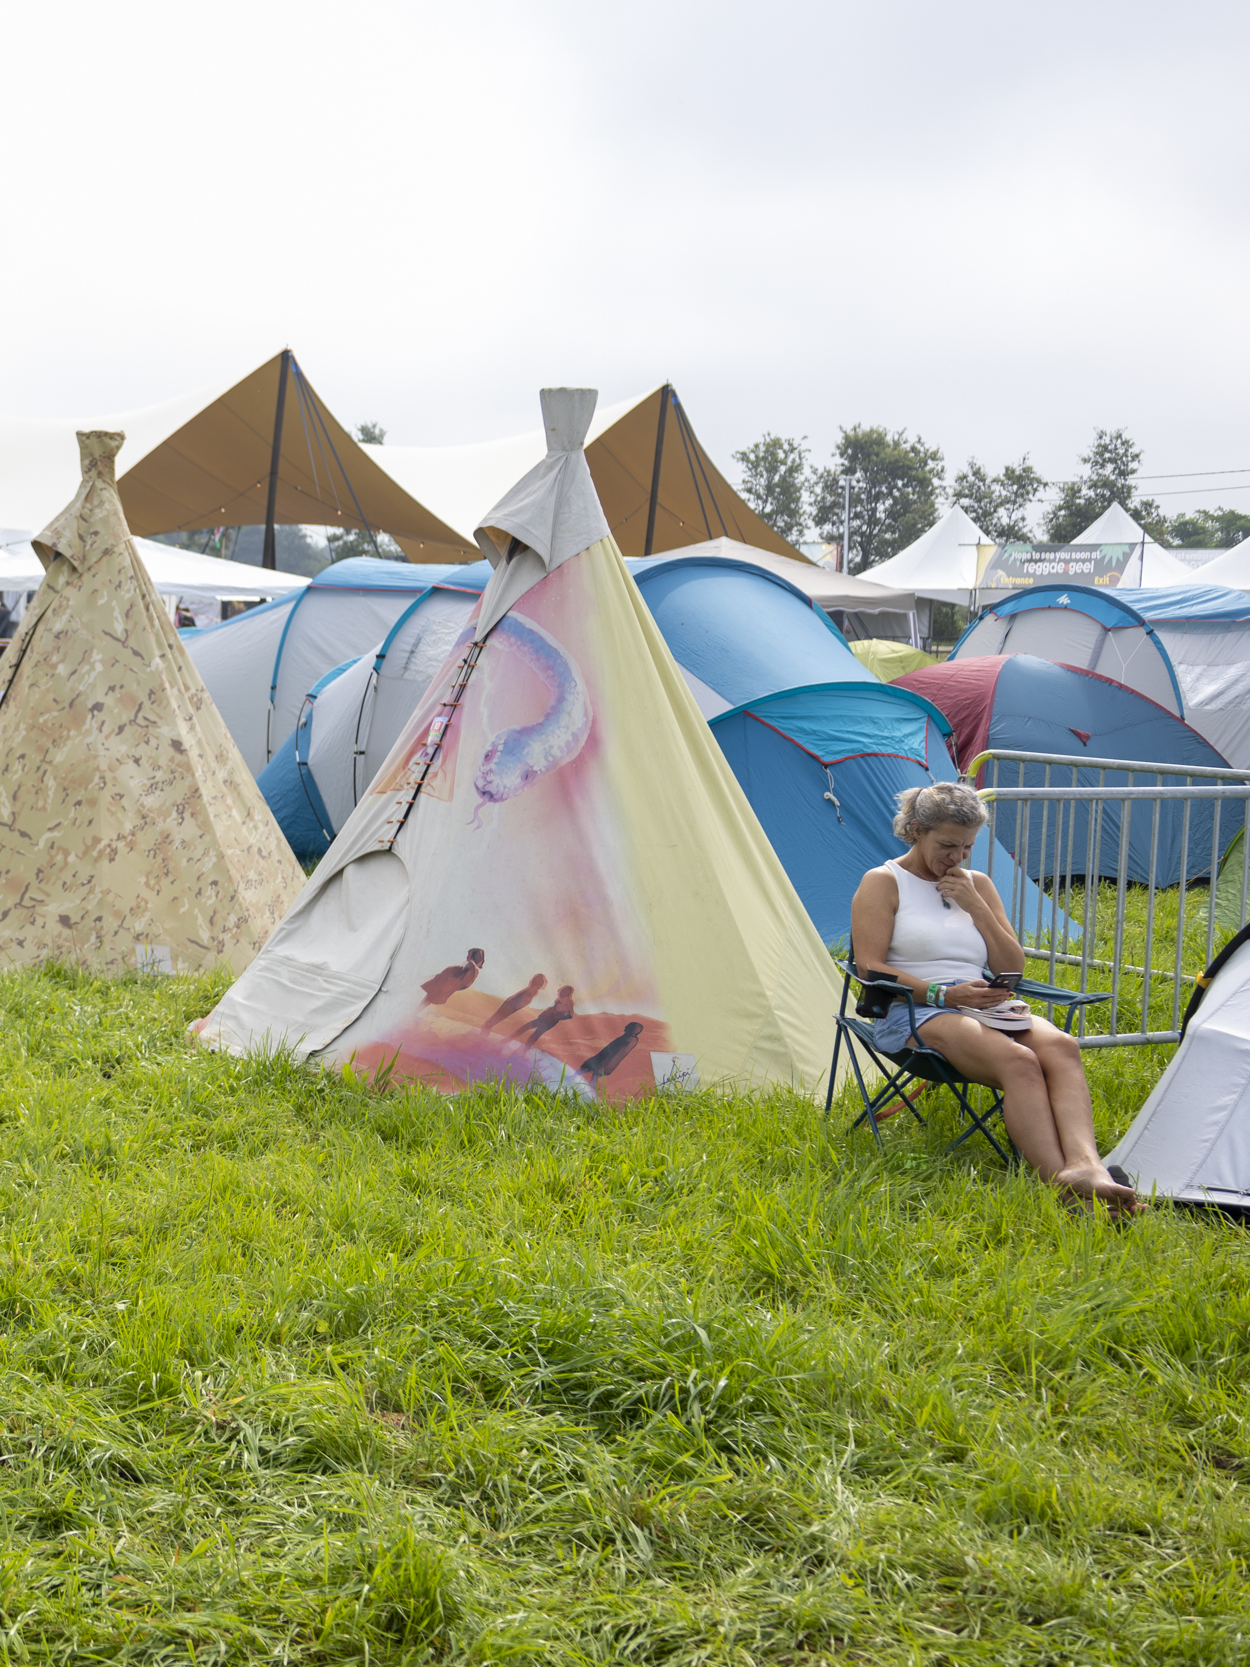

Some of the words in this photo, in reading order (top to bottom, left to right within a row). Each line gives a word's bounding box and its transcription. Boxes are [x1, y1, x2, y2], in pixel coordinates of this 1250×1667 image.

[1012, 551, 1032, 562] Hope
[1032, 551, 1040, 560] to
[1041, 552, 1055, 560] see
[1055, 552, 1071, 562] you
[1071, 551, 1091, 559] soon
[1091, 550, 1100, 559] at
[1024, 561, 1064, 575] reggae
[1068, 560, 1094, 575] geel
[1001, 576, 1034, 585] Entrance
[1094, 576, 1110, 585] Exit
